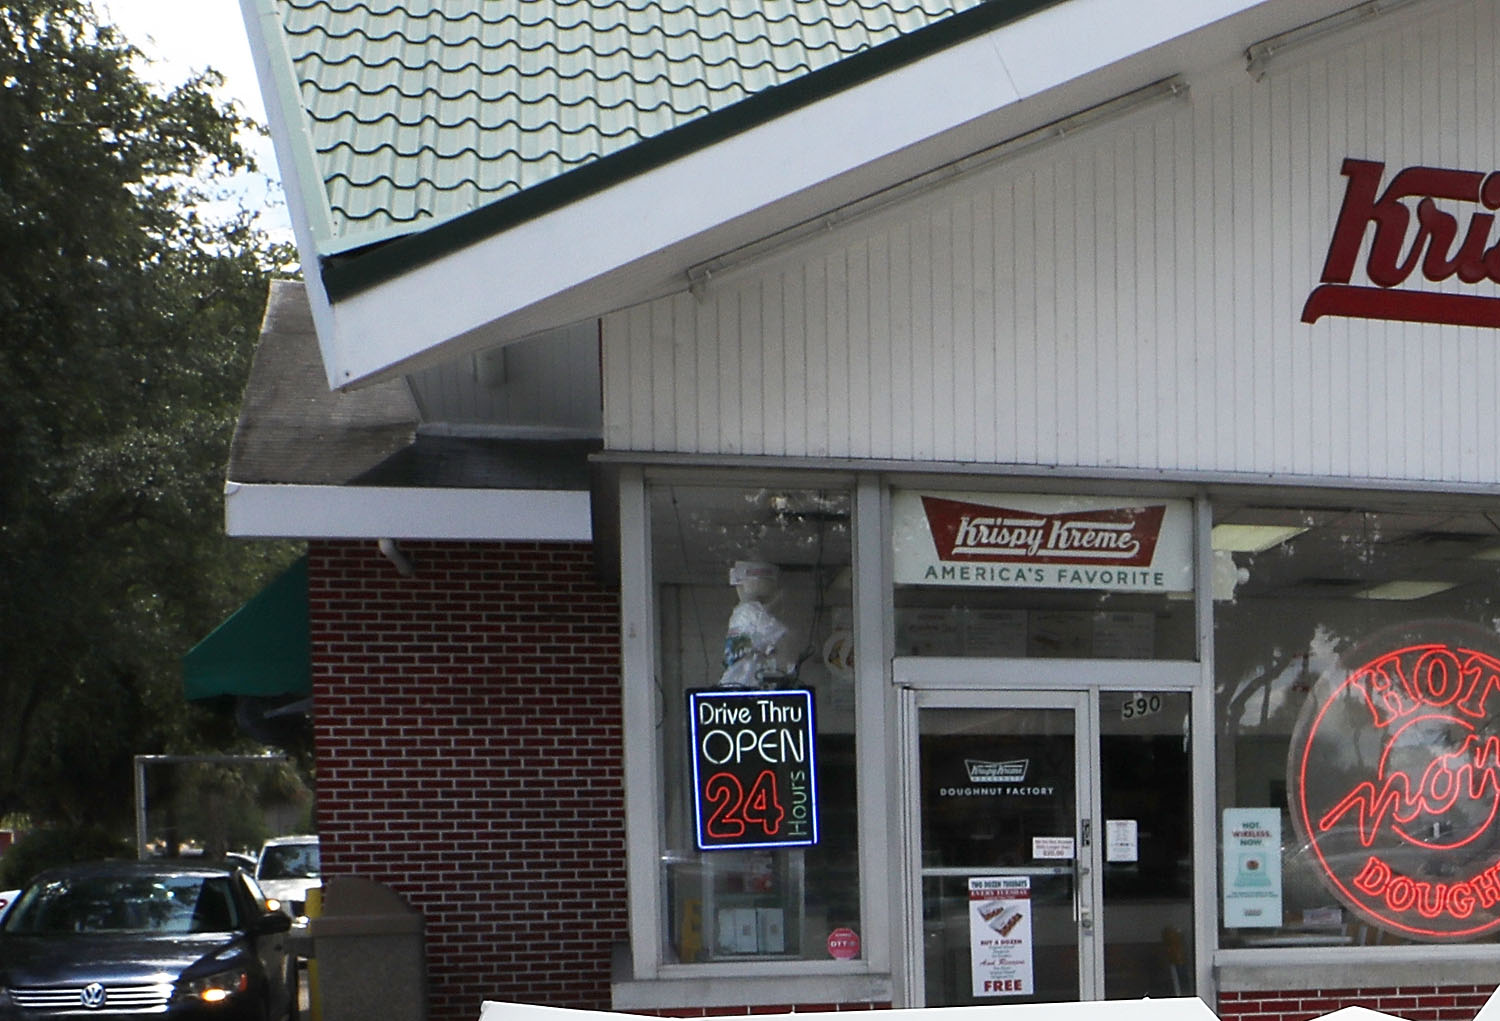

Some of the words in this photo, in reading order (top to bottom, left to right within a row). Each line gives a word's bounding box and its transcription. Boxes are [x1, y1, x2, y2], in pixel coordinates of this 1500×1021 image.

[952, 516, 1047, 556] Krispy
[1046, 519, 1140, 559] Kreme
[924, 565, 1045, 582] AMERICA'S
[1057, 568, 1165, 586] FAVORITE
[699, 702, 752, 725] Drive
[756, 700, 802, 723] Thru
[1122, 696, 1161, 719] 590
[702, 728, 805, 764] OPEN
[705, 769, 785, 838] 24
[787, 769, 808, 836] Hours
[939, 787, 1003, 797] DOUGHNUT
[1006, 786, 1054, 796] FACTORY
[983, 979, 1023, 992] FREE
